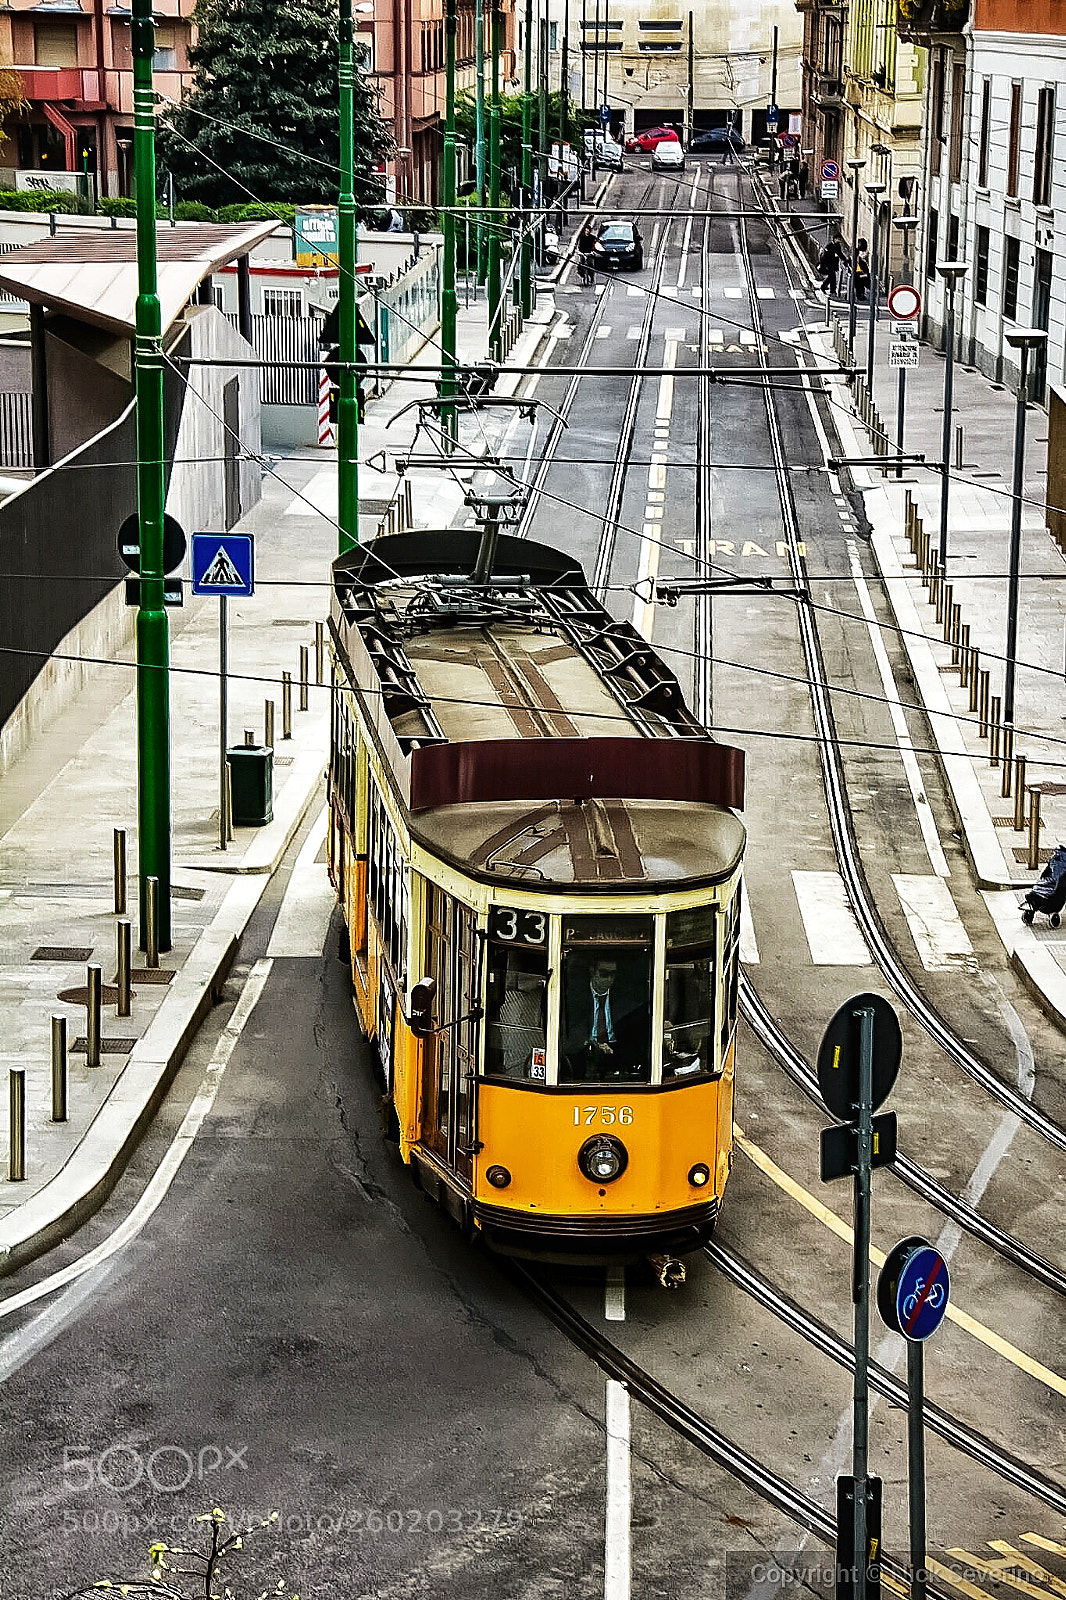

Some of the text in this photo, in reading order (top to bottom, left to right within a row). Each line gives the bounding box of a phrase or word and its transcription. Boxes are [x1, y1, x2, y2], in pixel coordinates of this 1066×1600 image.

[685, 343, 770, 353] TRAM
[673, 538, 807, 557] TRAM
[496, 908, 546, 944] 33
[533, 1066, 545, 1078] 33
[573, 1106, 634, 1126] 1756
